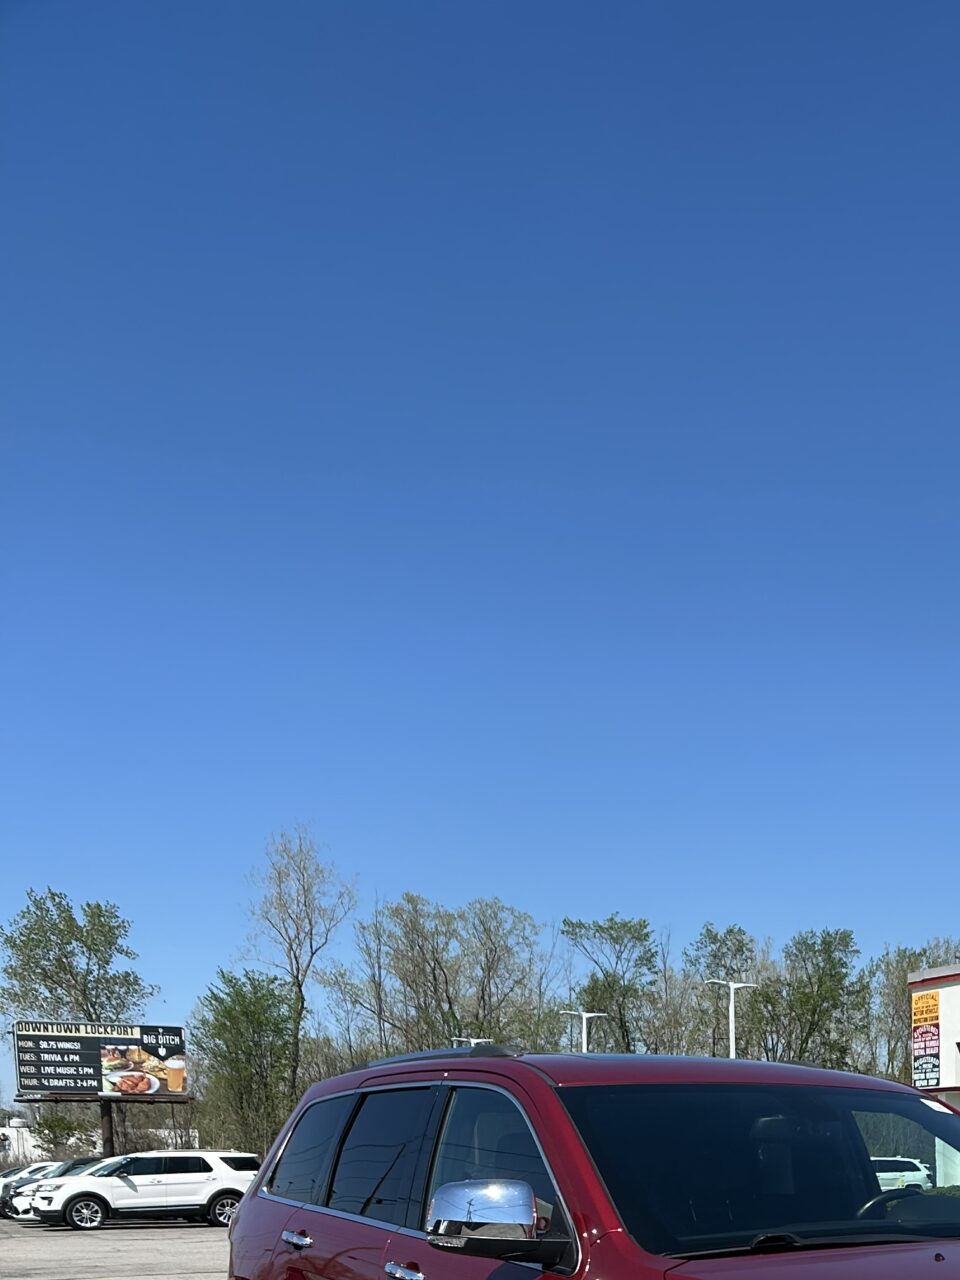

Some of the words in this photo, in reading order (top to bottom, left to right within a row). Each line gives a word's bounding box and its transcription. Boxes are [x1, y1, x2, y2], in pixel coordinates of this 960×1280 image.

[18, 1022, 80, 1034] DOWNTOWN
[84, 1024, 135, 1036] LOCKPORT
[142, 1034, 156, 1044] BIG
[158, 1035, 180, 1045] DITCH
